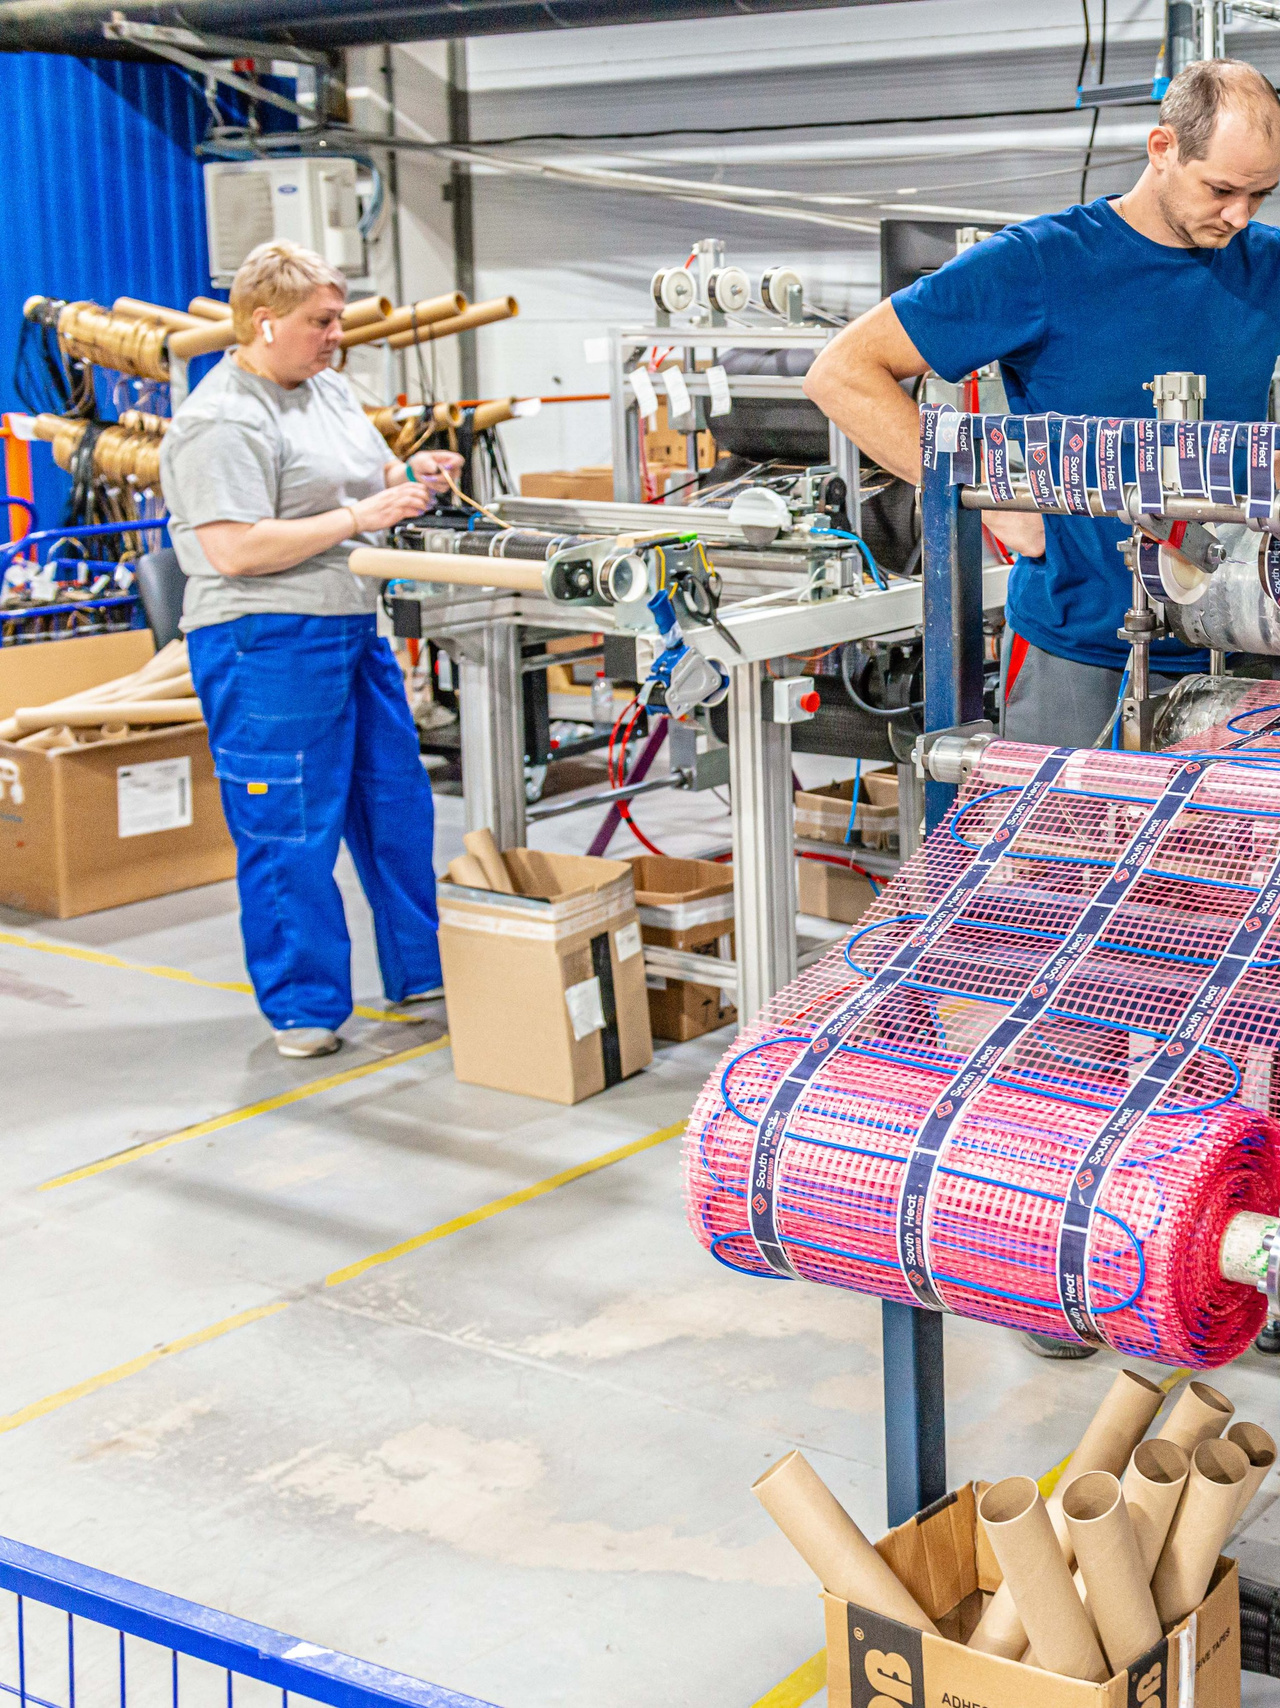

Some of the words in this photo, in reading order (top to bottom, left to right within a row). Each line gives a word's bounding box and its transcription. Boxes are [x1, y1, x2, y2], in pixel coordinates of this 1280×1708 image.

[925, 412, 935, 441] South
[959, 426, 969, 452] Heat
[1145, 420, 1155, 442] outh
[1185, 432, 1196, 459] Heat
[1218, 428, 1231, 455] Heat
[1258, 441, 1269, 468] Heat
[923, 445, 933, 468] Hea
[995, 449, 1004, 478] South
[1070, 456, 1080, 485] South
[1145, 446, 1155, 472] Heat
[997, 481, 1009, 501] Hea
[1037, 469, 1049, 498] South
[1106, 465, 1117, 491] Heat
[1072, 488, 1085, 511] Heat
[1006, 802, 1028, 826] South
[1023, 781, 1043, 800] Heat
[1124, 842, 1147, 865] South
[1141, 818, 1161, 839] Heat
[944, 888, 967, 908] Heat
[1256, 889, 1279, 914] South
[1044, 956, 1069, 980] South
[1064, 933, 1087, 954] Heat
[827, 1011, 855, 1035] South
[1179, 1011, 1204, 1040] South
[1197, 984, 1220, 1009] Heat
[950, 1071, 977, 1097] South
[972, 1045, 997, 1068] Heat
[760, 1115, 778, 1147] Heat
[1088, 1134, 1115, 1165] South
[1109, 1107, 1135, 1132] Heat
[756, 1152, 768, 1188] South
[903, 1193, 917, 1227] Heat
[904, 1232, 917, 1266] South
[1063, 1272, 1077, 1303] Heat
[1069, 1307, 1088, 1332] South
